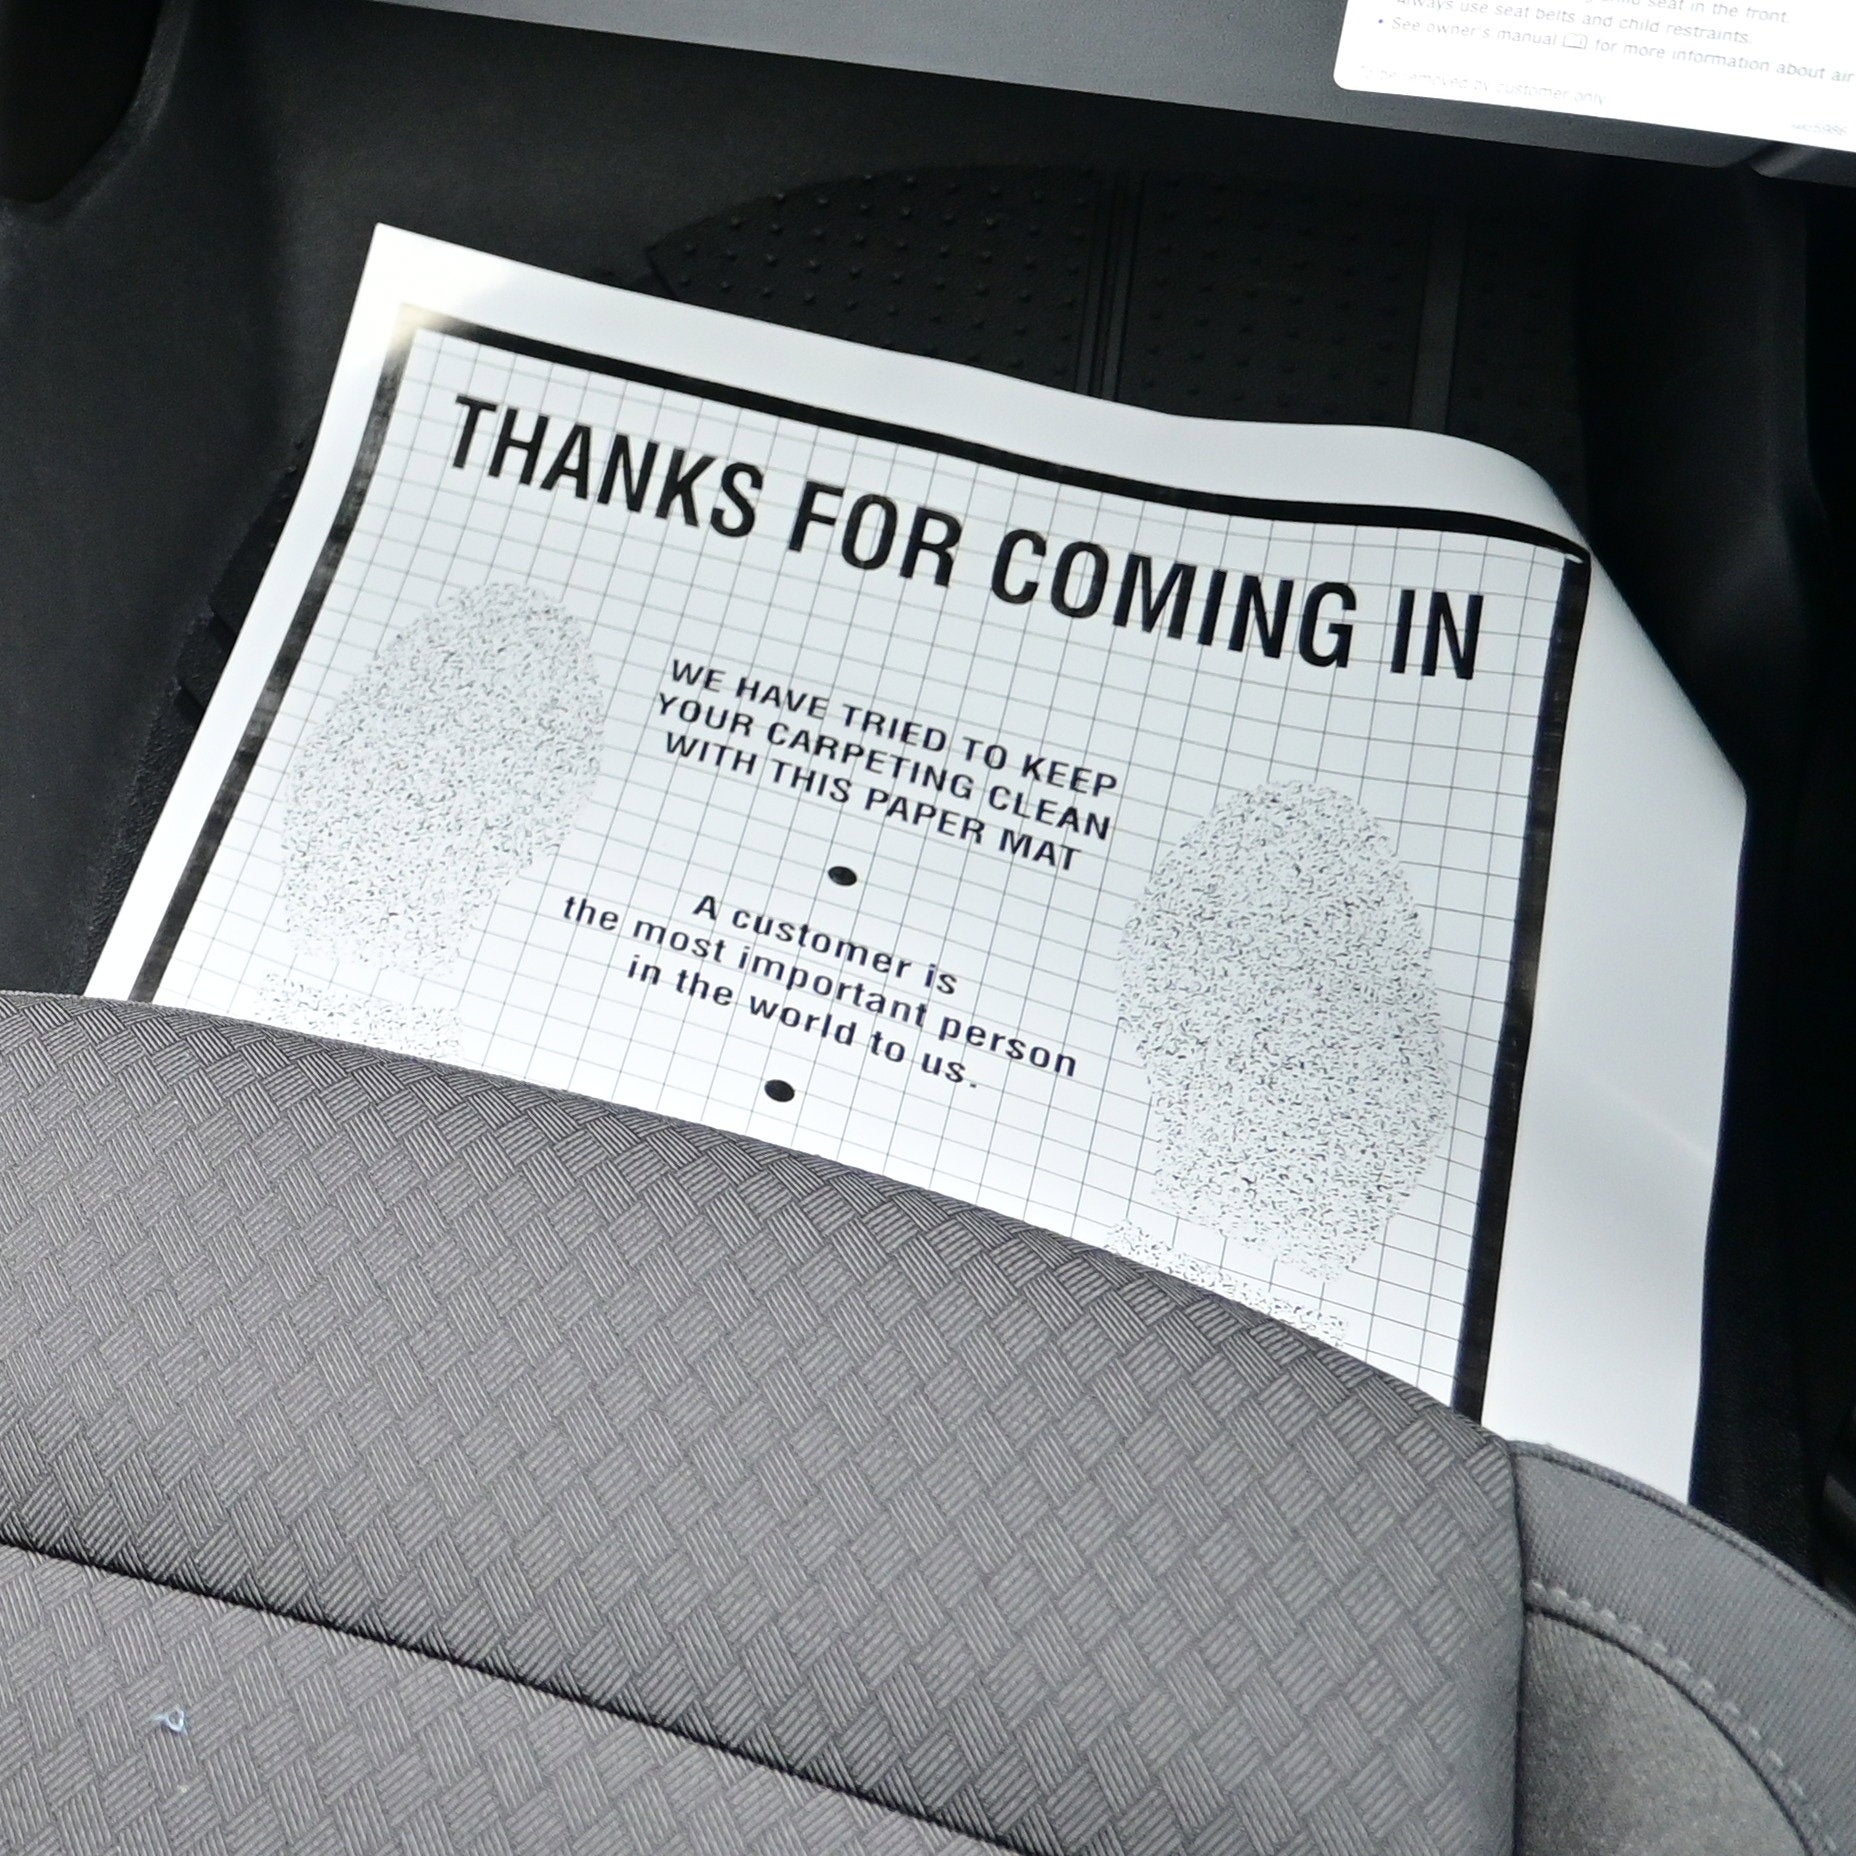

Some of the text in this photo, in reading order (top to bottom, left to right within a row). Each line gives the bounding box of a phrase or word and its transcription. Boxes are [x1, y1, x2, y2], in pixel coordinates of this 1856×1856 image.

[1497, 27, 1557, 45] manual
[1623, 44, 1665, 59] more
[1672, 49, 1770, 73] information
[1776, 63, 1825, 79] about
[1619, 17, 1659, 33] child
[1712, 2, 1738, 17] the
[449, 394, 1486, 681] THANKS FOR COMING IN
[658, 692, 1112, 841] YOUR CARPETING CLEAN
[669, 658, 1119, 797] WE HAVE TRIED TO KEEP
[665, 732, 1083, 872] WITH THIS PAPER MAT
[563, 895, 1079, 1078] the most important person
[693, 894, 959, 996] A customer is
[627, 953, 978, 1089] in the world to us.
